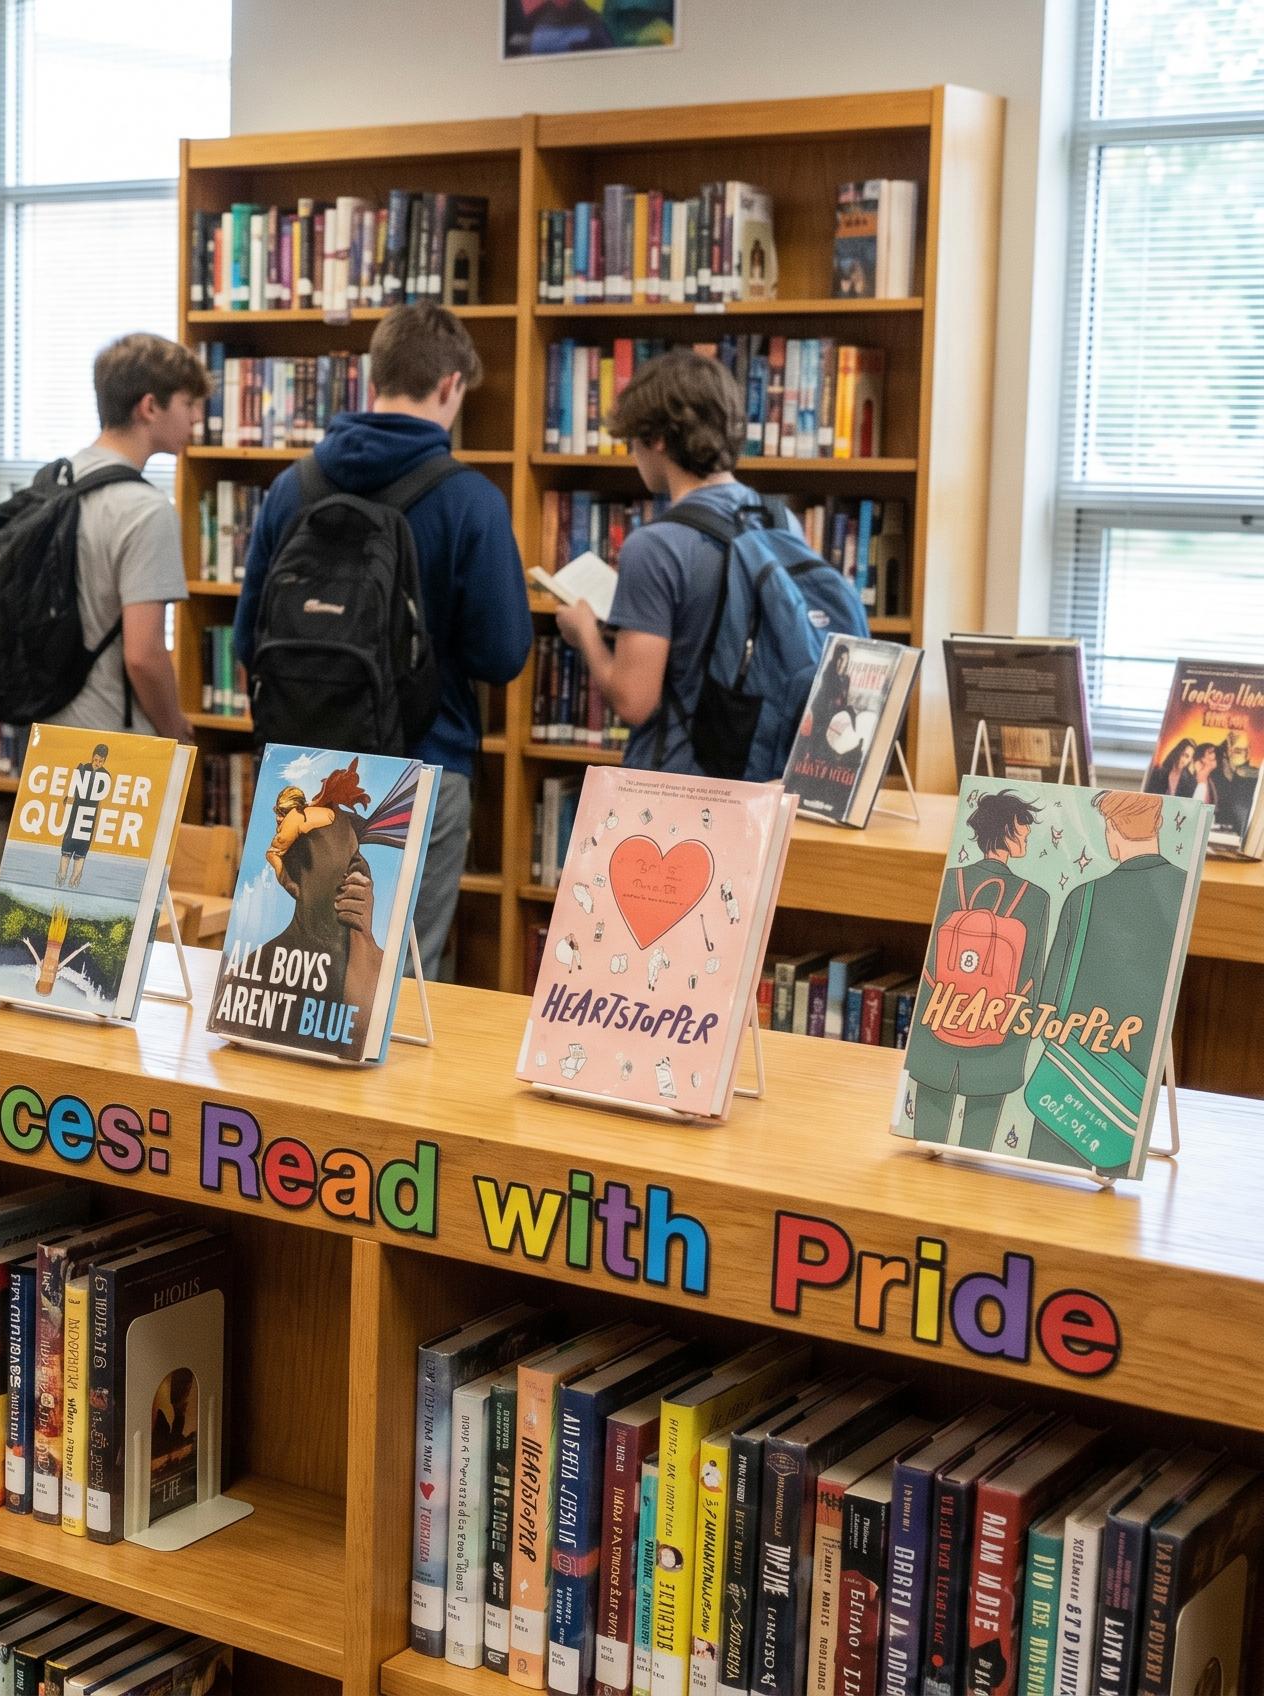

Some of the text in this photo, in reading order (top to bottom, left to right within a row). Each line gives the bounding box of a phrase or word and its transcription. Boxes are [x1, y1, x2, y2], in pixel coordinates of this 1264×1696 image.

[28, 765, 152, 807] GENDER
[19, 800, 143, 847] QUEER
[224, 940, 331, 992] ALL BOYS
[216, 984, 359, 1045] AREN'T BLUE
[541, 984, 718, 1045] HEARTSTOPPER
[921, 982, 1143, 1053] HEARTSTOPPER
[200, 1101, 440, 1238] Read
[473, 1168, 711, 1296] with
[771, 1210, 1122, 1377] Pride
